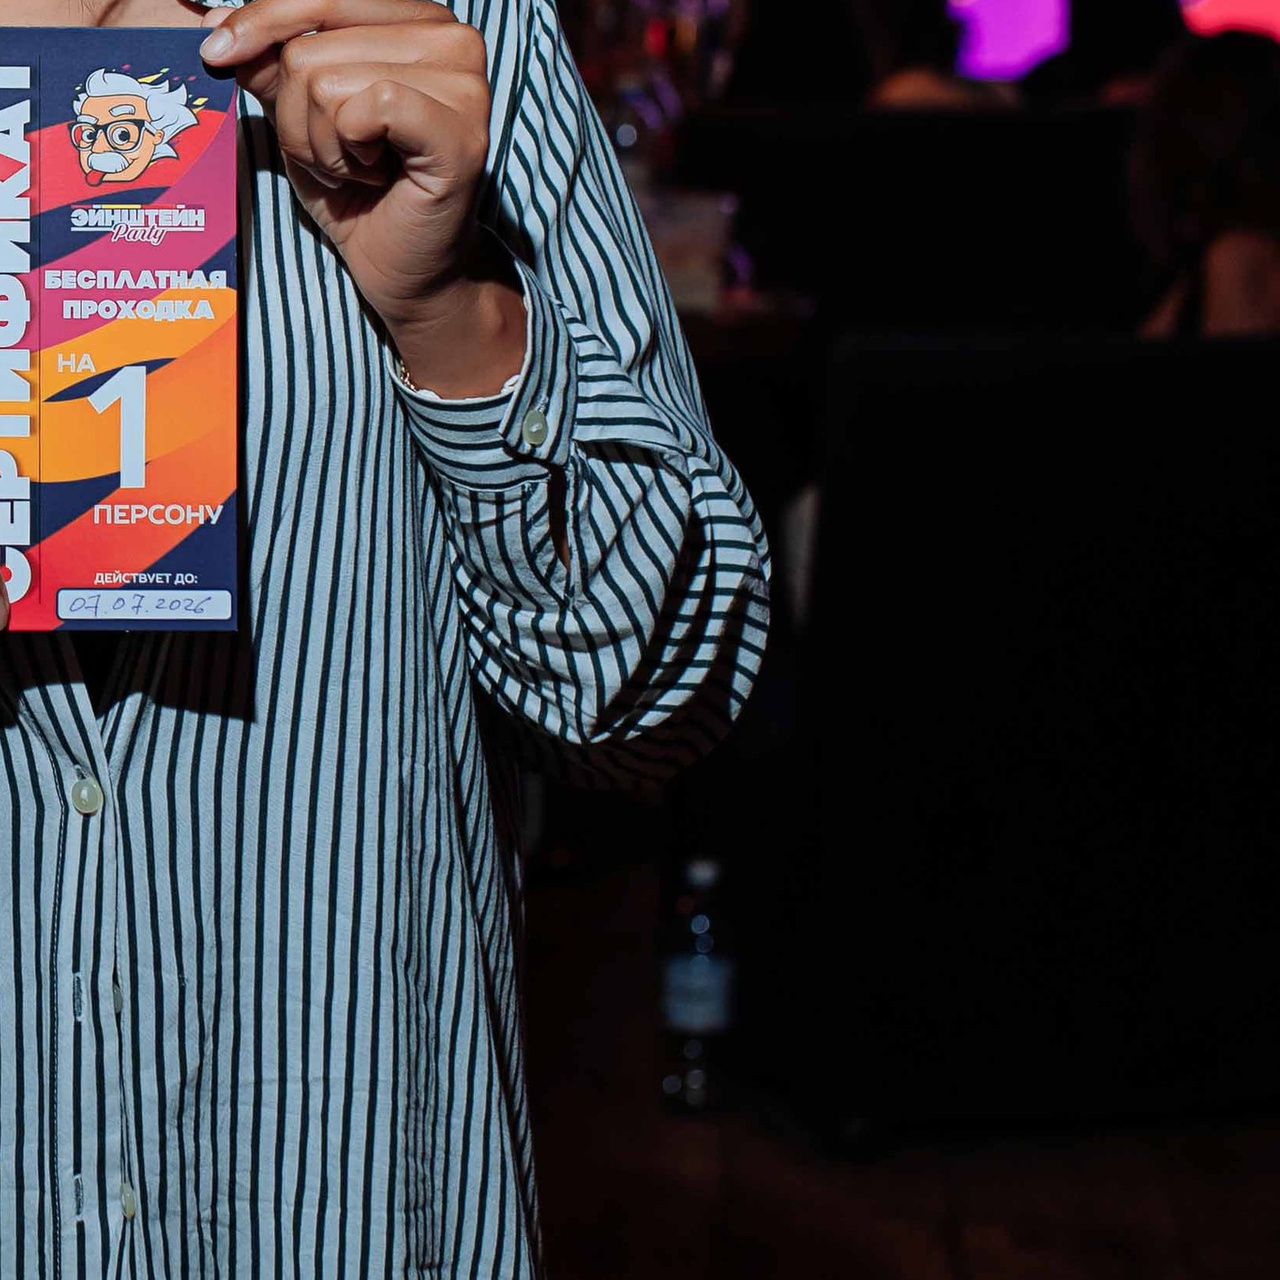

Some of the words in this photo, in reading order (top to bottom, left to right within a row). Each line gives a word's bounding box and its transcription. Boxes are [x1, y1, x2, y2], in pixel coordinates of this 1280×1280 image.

[71, 205, 205, 227] ЭЙНШТЕЙН
[111, 222, 169, 246] Party
[44, 270, 227, 290] БЕСПЛАТНАЯ
[63, 300, 216, 322] ПРОХОДКА
[57, 353, 96, 373] НА
[86, 365, 147, 489] 1
[93, 504, 224, 525] ПЕРСОНУ
[94, 570, 171, 585] ДЕЙСТВУЕТ
[174, 573, 198, 585] ДО:
